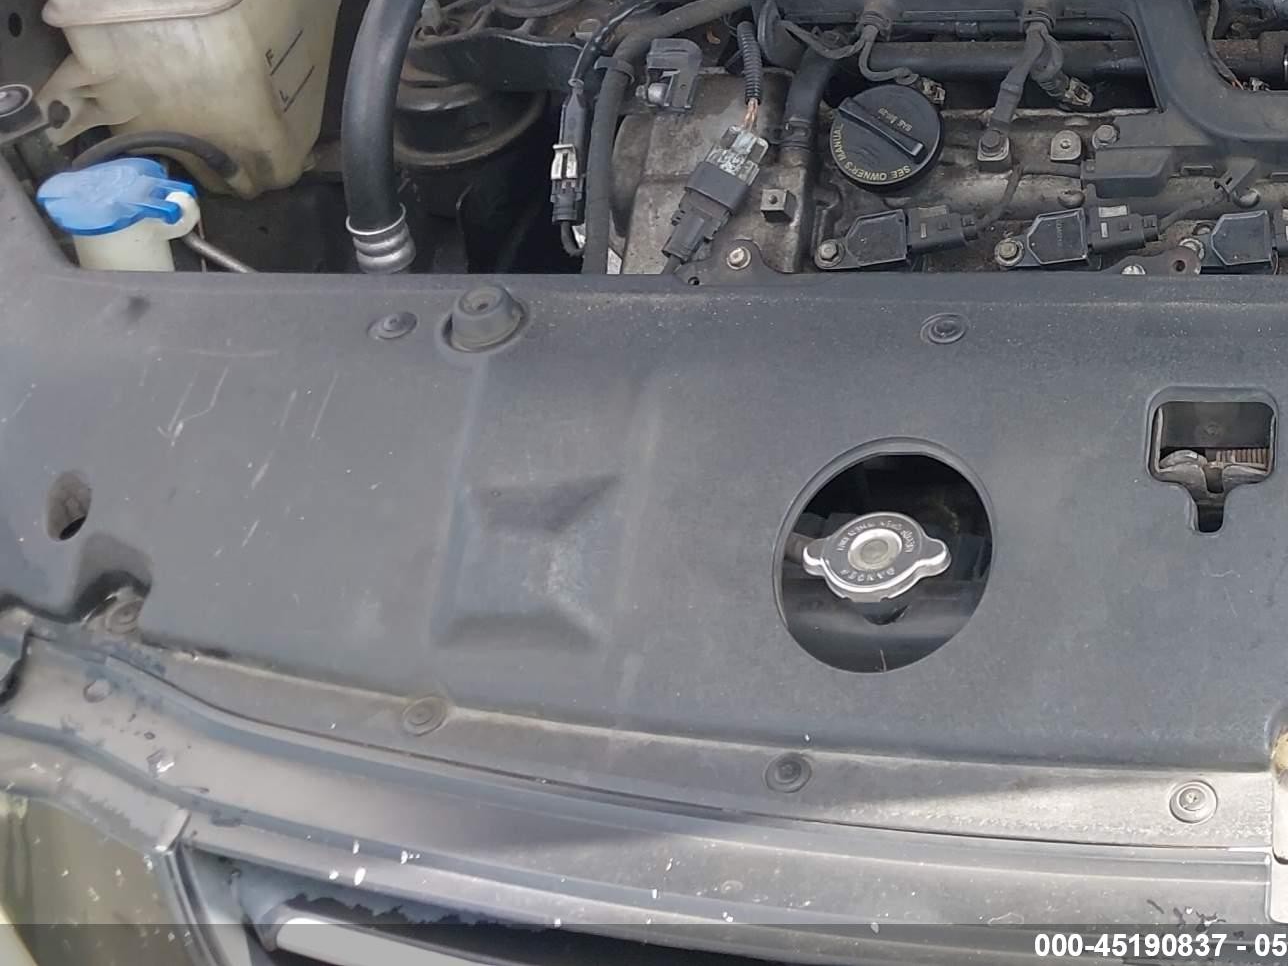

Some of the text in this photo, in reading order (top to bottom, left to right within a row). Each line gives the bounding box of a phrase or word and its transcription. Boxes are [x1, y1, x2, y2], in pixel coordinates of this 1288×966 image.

[265, 49, 274, 68] F
[832, 123, 912, 181] SEE OWNER'S MANUAL
